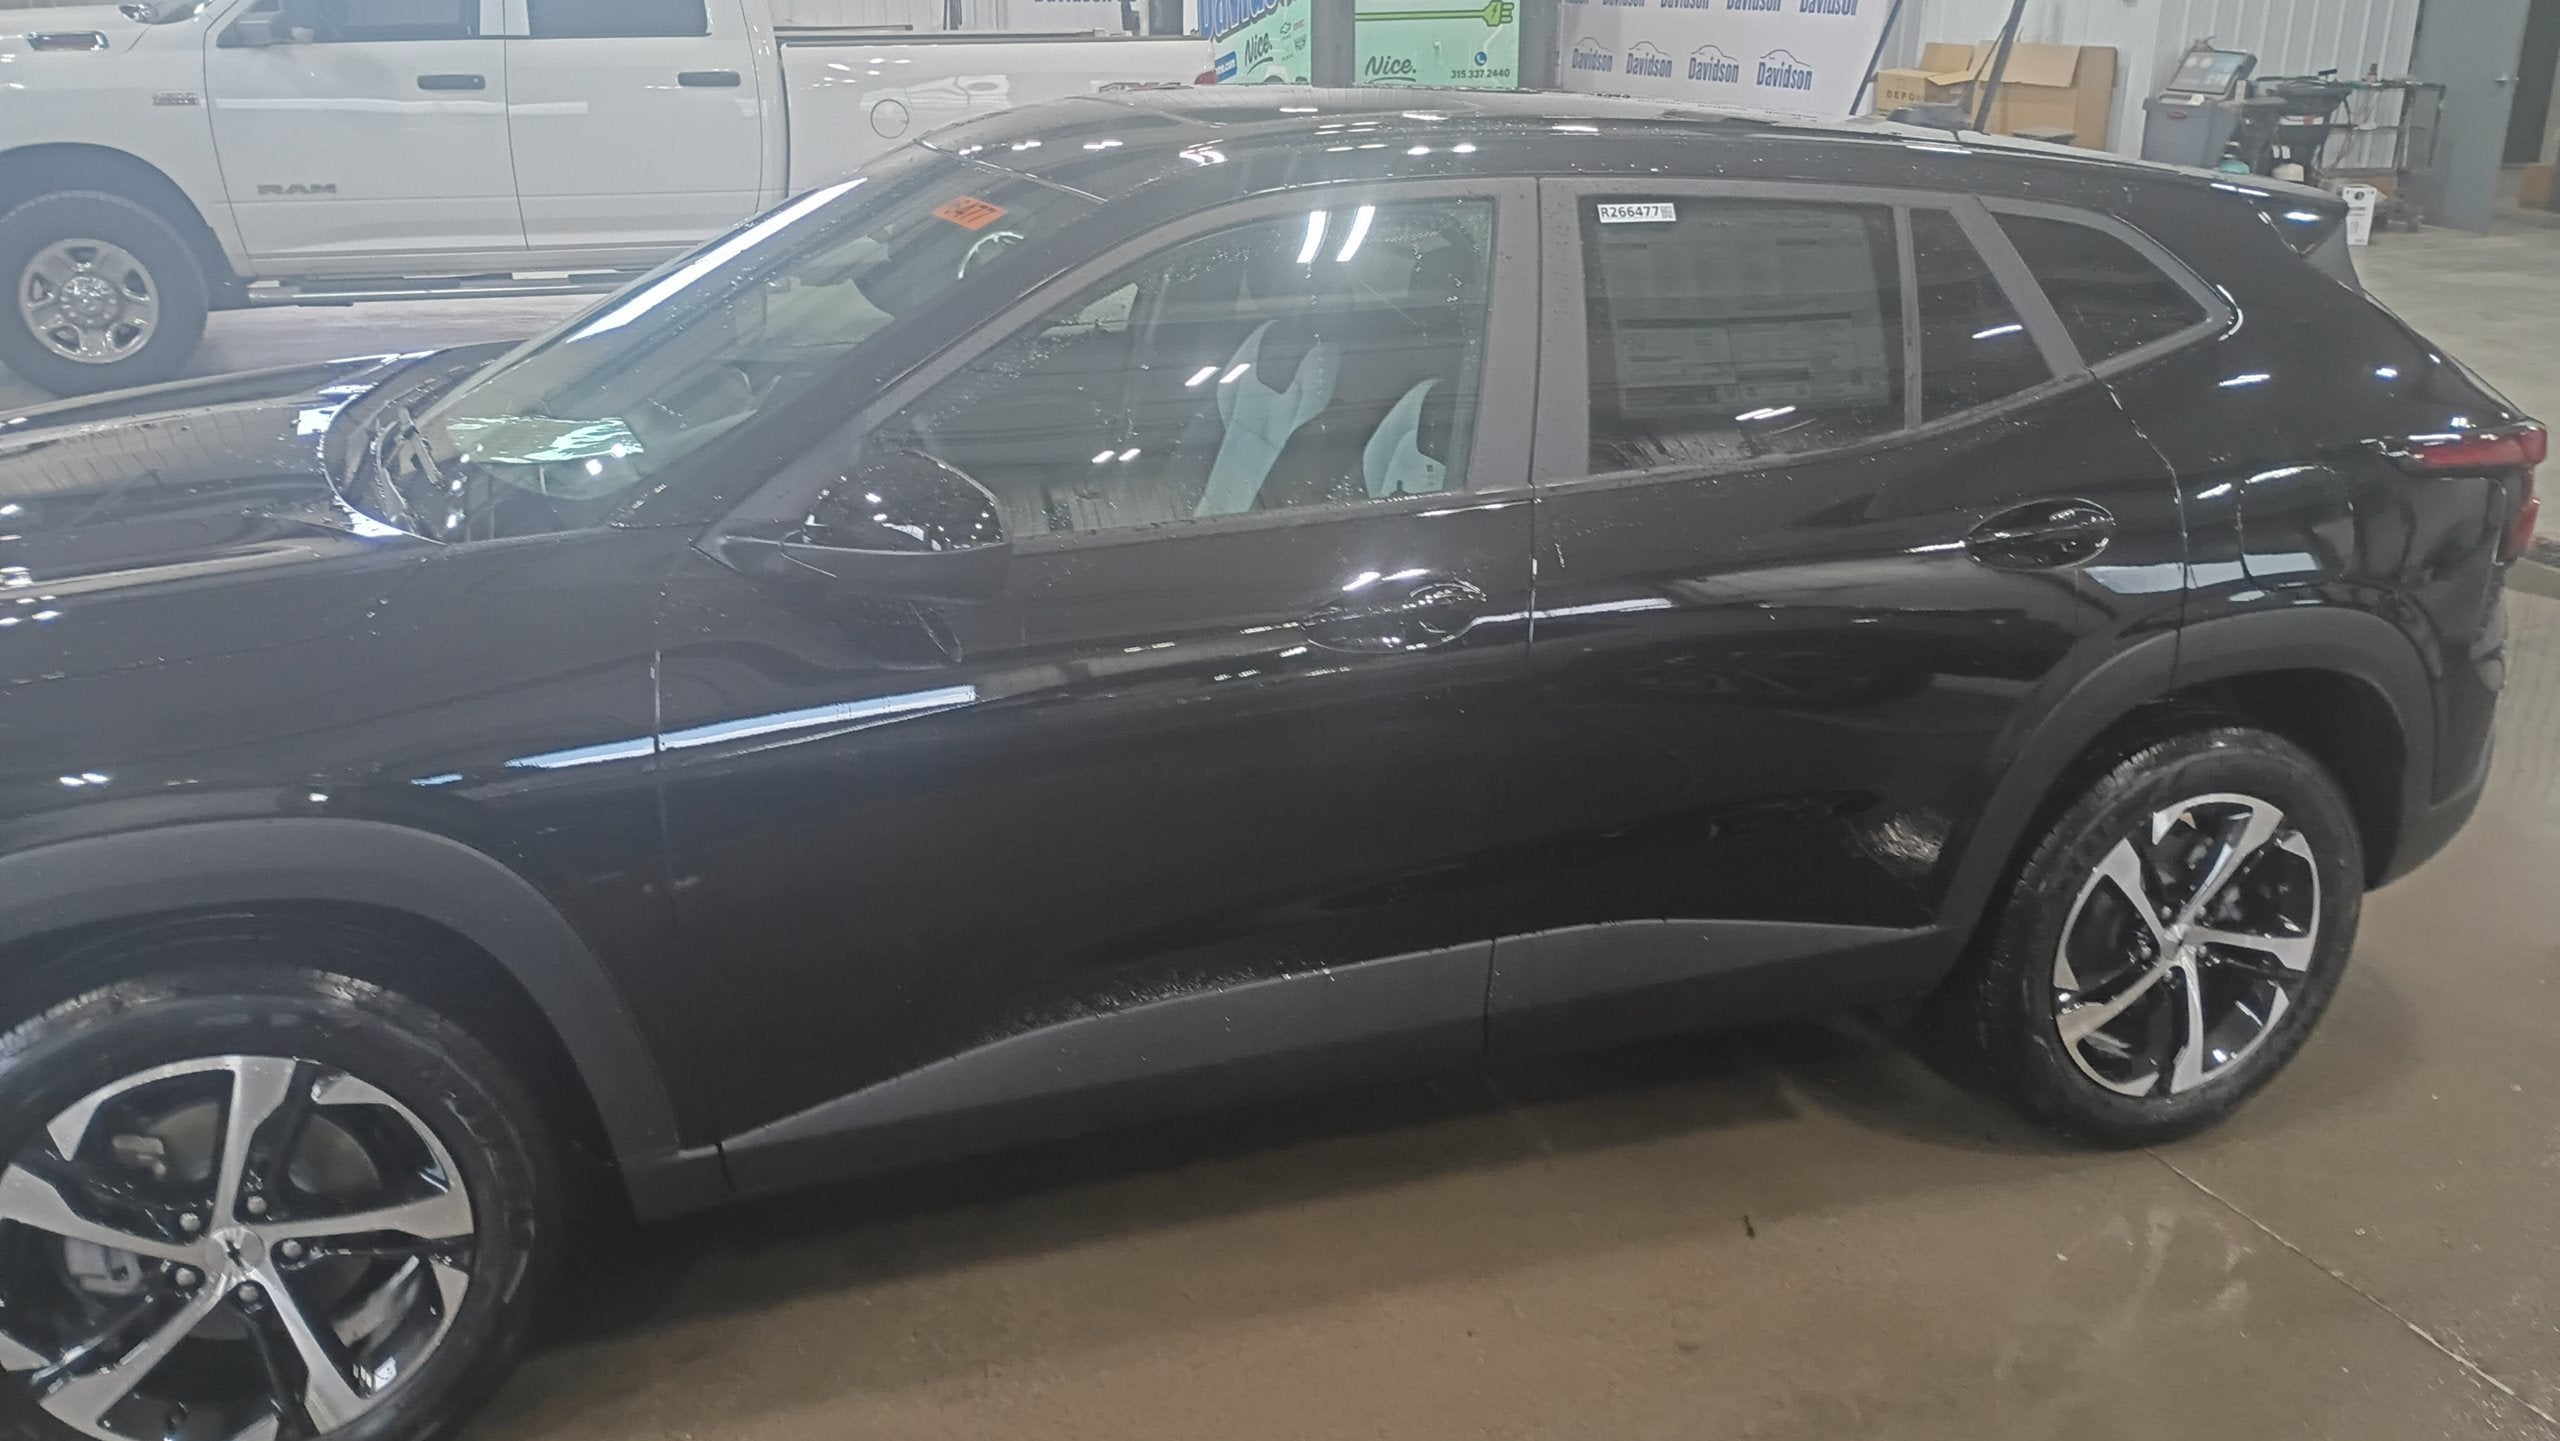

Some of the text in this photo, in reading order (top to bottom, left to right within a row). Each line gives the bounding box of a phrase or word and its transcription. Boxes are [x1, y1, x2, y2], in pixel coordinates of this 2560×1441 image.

[1365, 55, 1417, 76] Nice.
[1572, 48, 1613, 72] Davidson
[1626, 52, 1672, 78] Davidson
[1688, 57, 1740, 83] Davidson
[1451, 69, 1510, 79] 315 337 2440
[1756, 62, 1813, 90] Davidson
[257, 183, 337, 195] RAM
[1601, 206, 1659, 218] R266477
